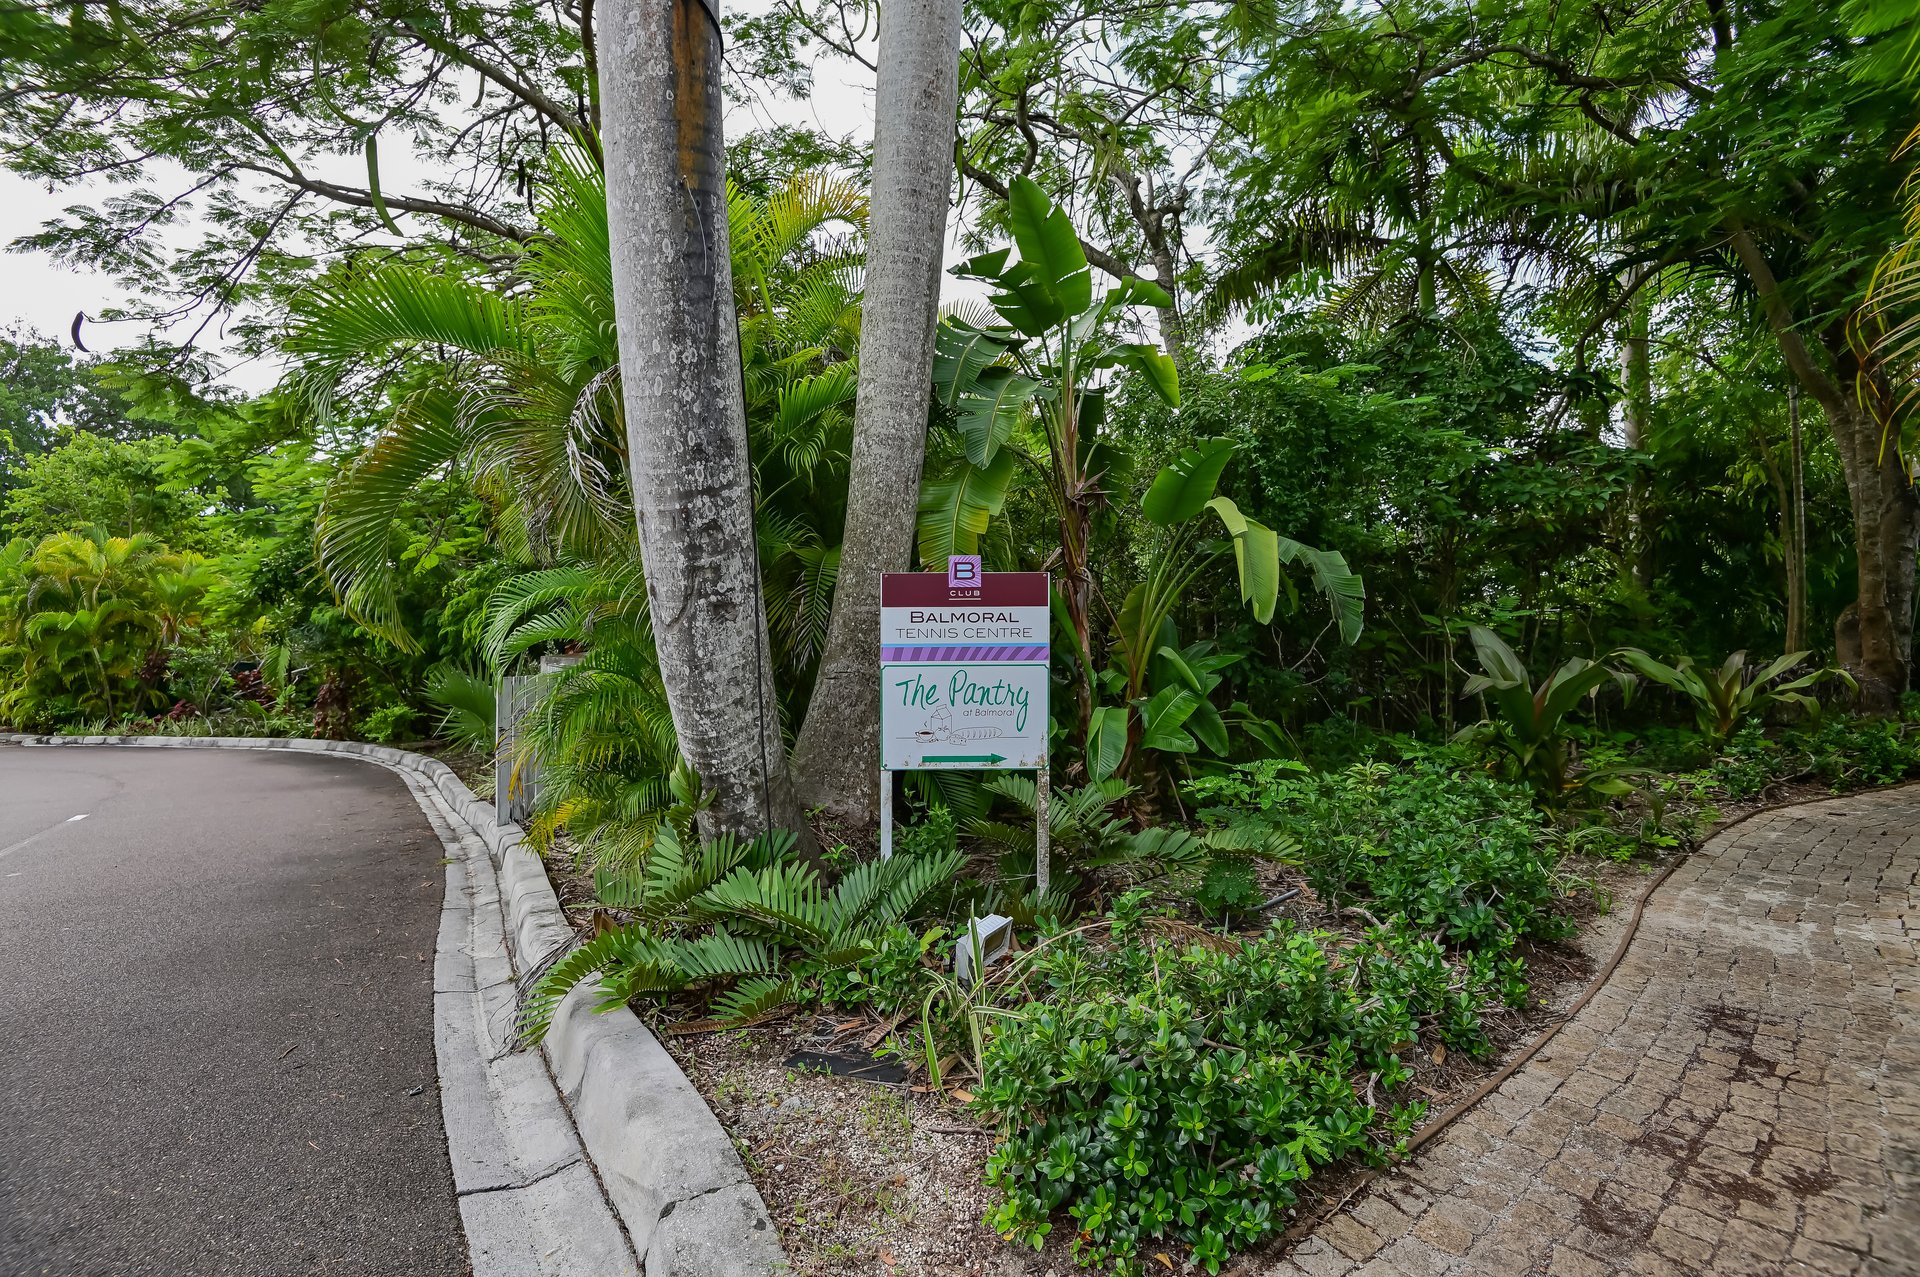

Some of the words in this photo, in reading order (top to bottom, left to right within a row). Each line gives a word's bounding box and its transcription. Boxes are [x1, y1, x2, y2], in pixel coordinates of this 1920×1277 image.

[954, 561, 975, 580] B
[910, 611, 1019, 623] BALMORAL
[896, 627, 959, 639] TENNIS
[963, 627, 1033, 638] CENTRE
[895, 673, 940, 710] The
[949, 669, 1030, 732] Pantry
[962, 709, 973, 717] at
[975, 708, 1015, 717] Balmoral
